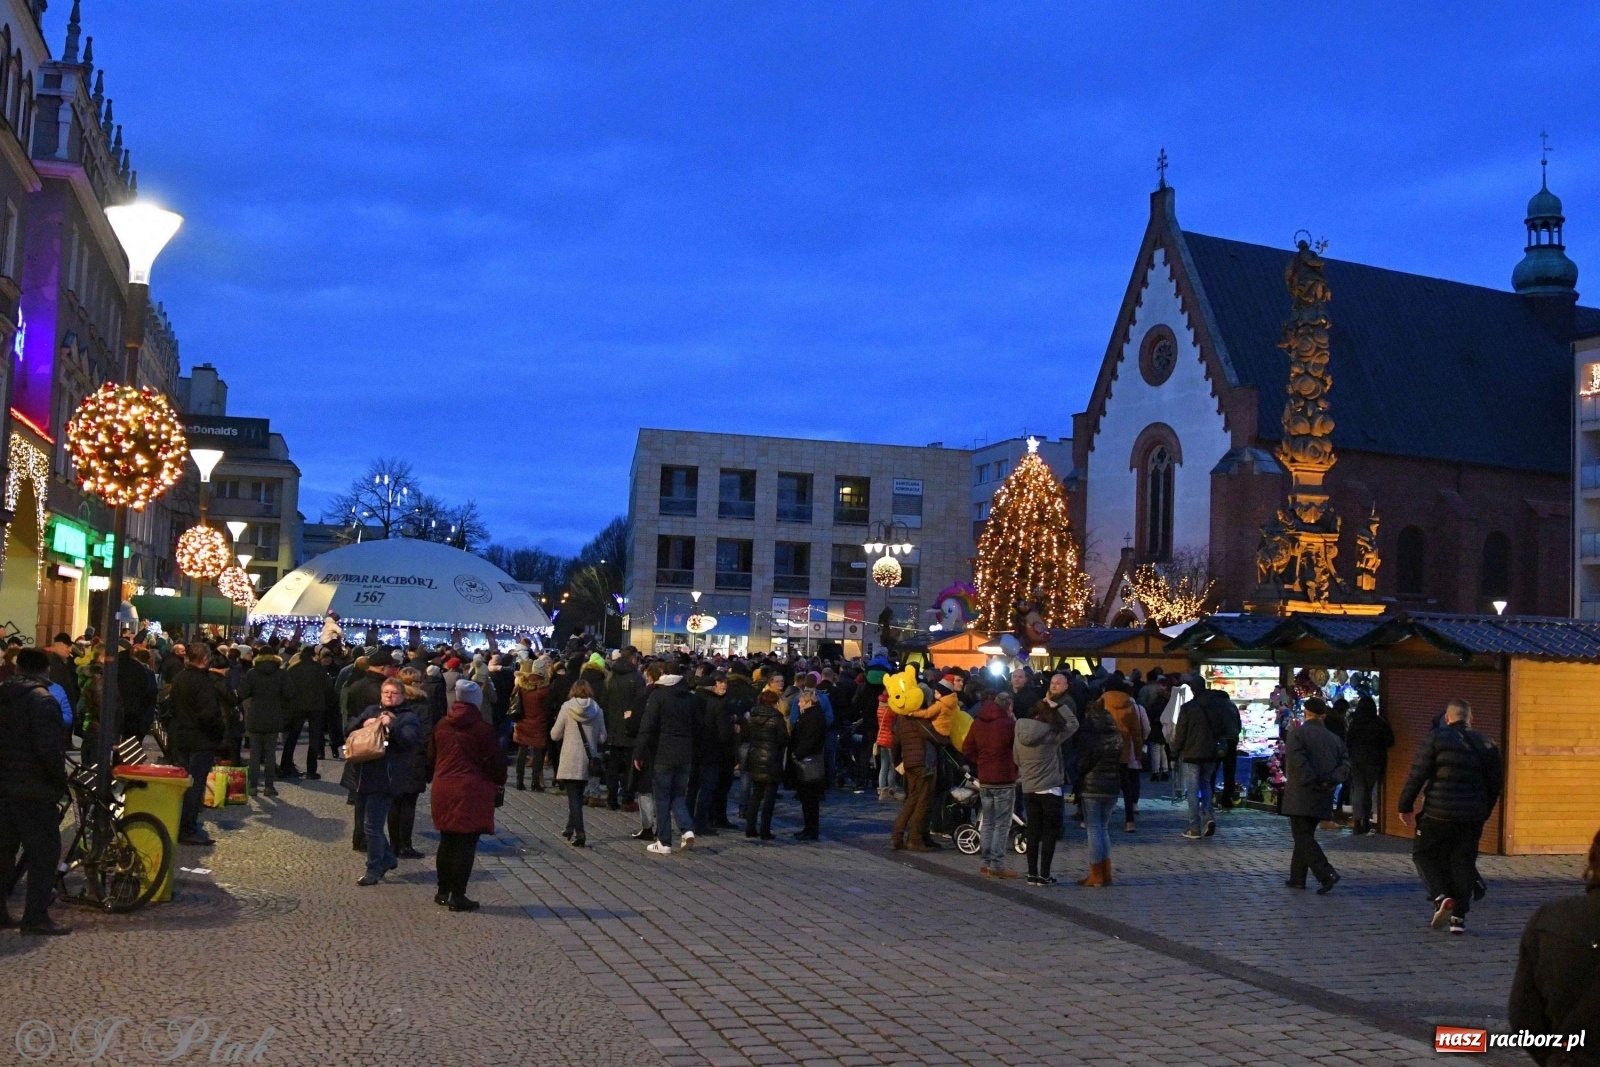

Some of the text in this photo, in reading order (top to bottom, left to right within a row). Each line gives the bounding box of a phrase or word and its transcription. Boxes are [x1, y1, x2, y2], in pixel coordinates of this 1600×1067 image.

[319, 573, 369, 584] BROWAR
[371, 574, 438, 590] RACIBÓRZ
[353, 591, 386, 604] 1567
